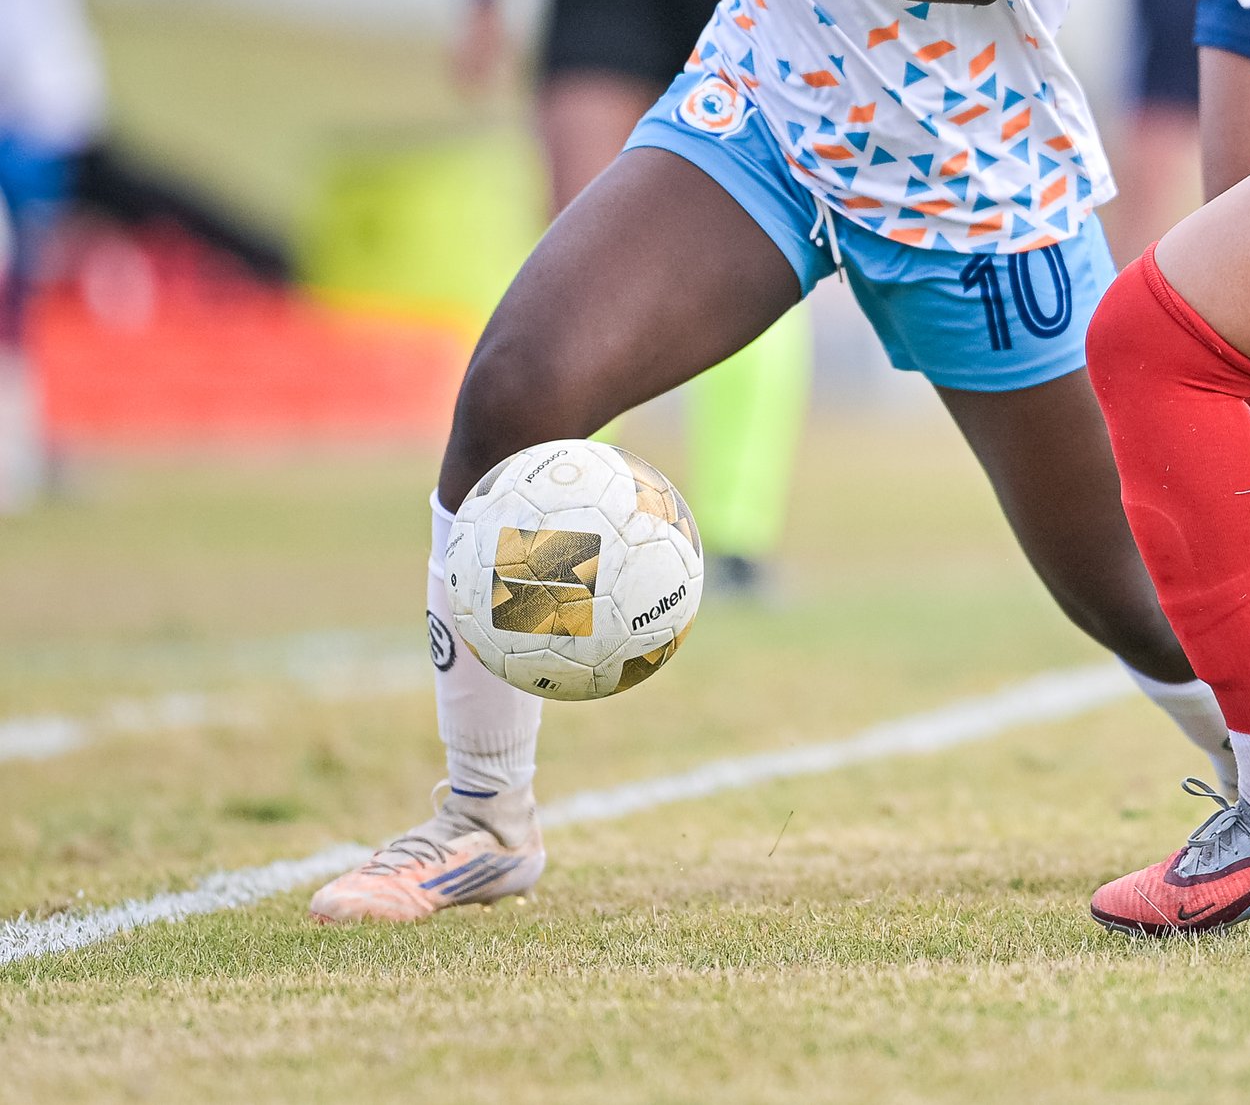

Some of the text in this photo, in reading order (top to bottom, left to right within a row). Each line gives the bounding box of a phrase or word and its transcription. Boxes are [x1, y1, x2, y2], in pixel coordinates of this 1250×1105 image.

[959, 242, 1072, 350] 10
[525, 450, 568, 483] Concacaf
[632, 584, 687, 631] molten
